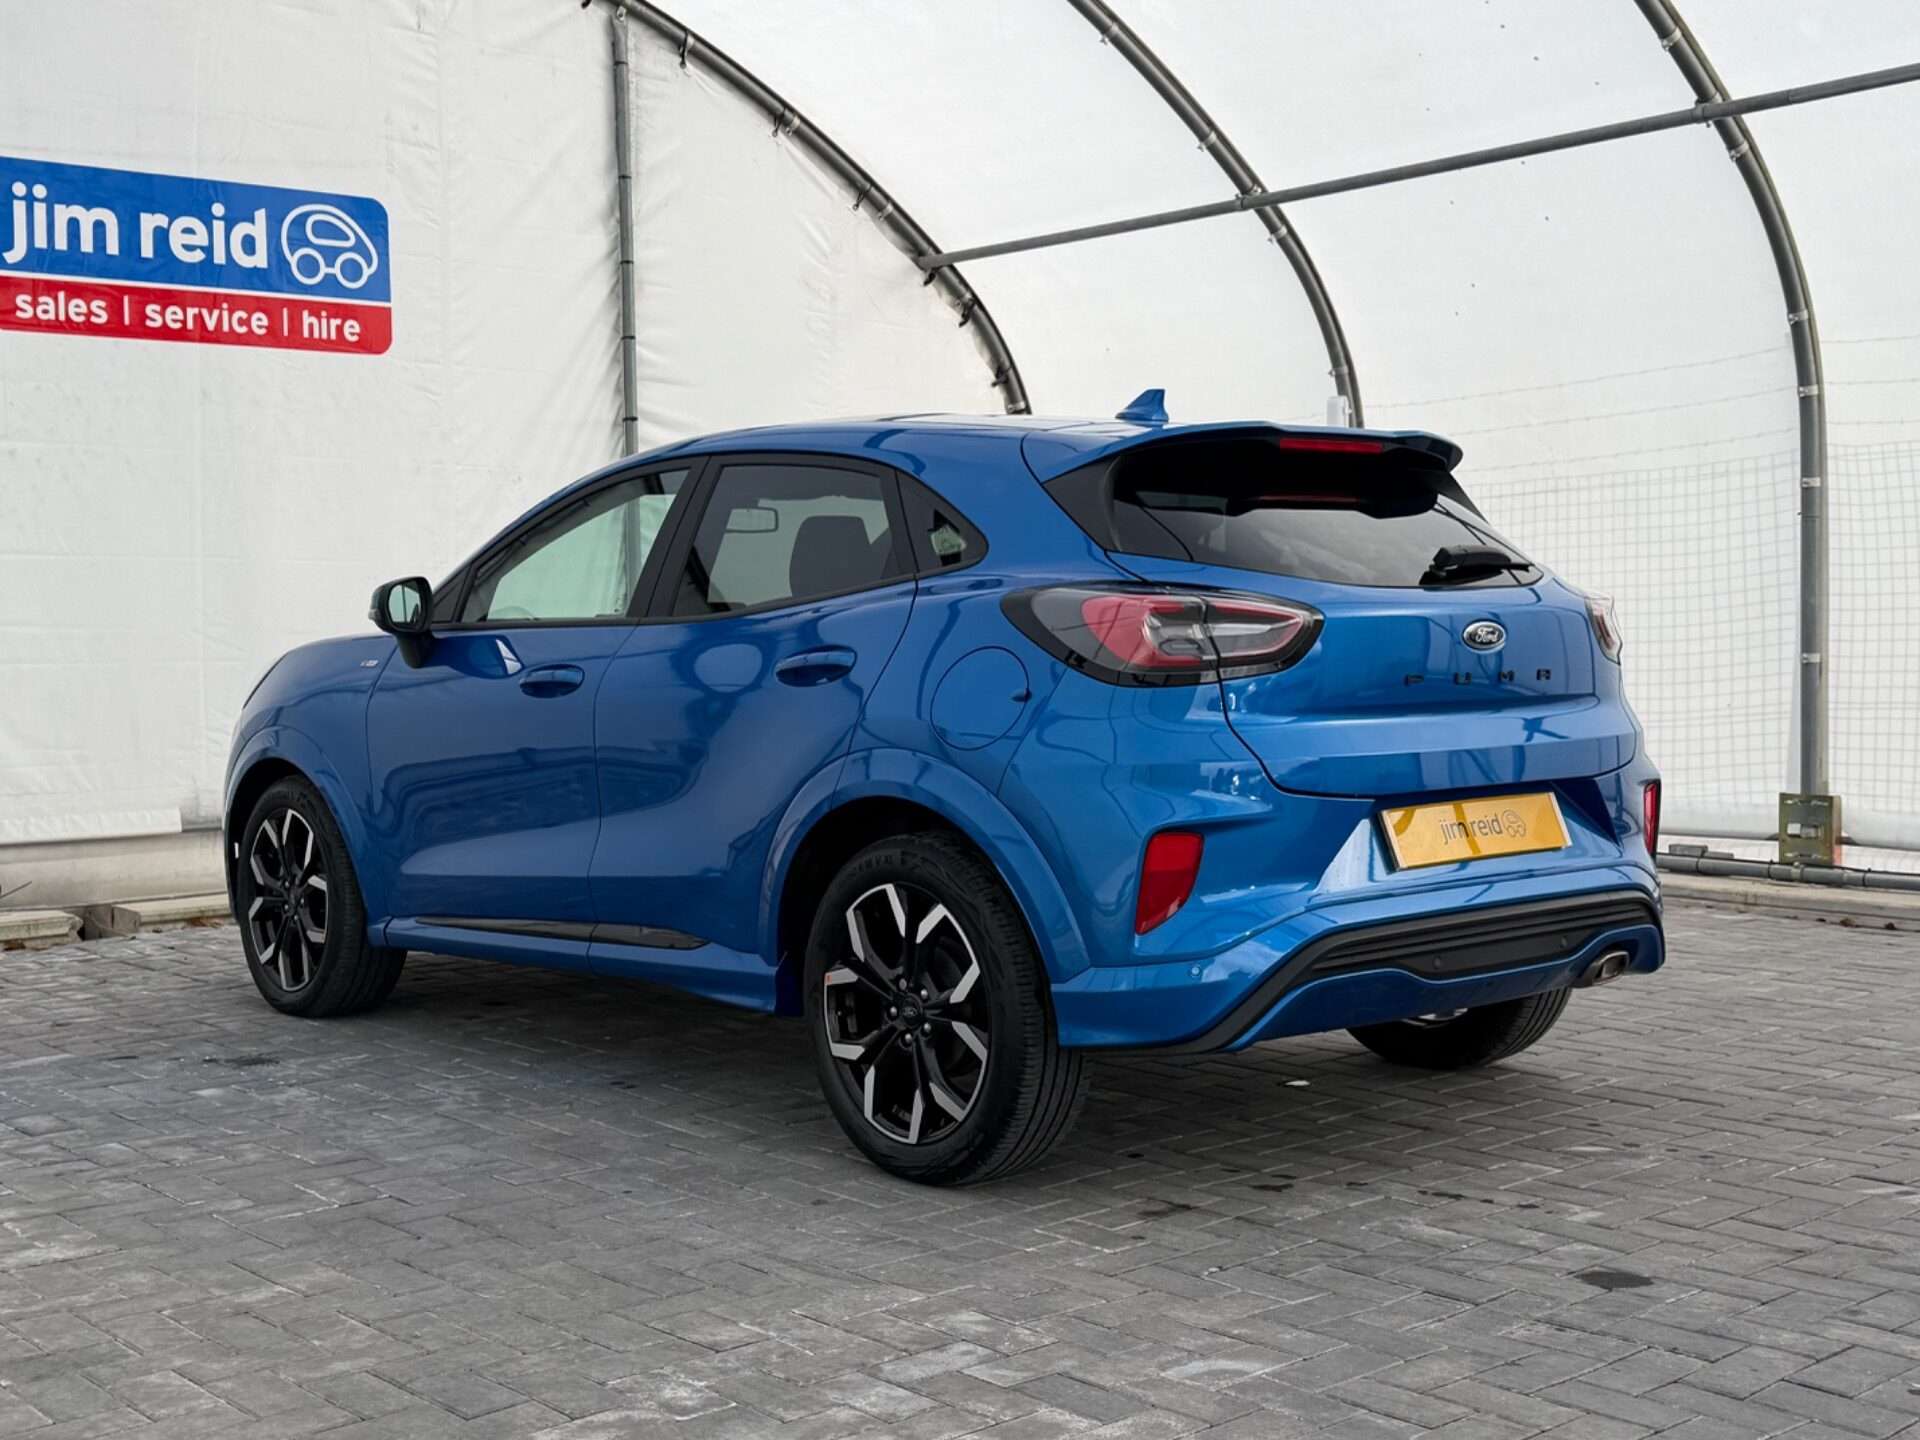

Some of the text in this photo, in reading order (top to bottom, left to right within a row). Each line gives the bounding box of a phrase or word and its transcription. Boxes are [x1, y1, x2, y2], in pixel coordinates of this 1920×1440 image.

[2, 181, 268, 269] jim reid
[15, 291, 361, 342] sales service hire
[1476, 626, 1499, 643] Ford
[1440, 812, 1503, 846] jim reid
